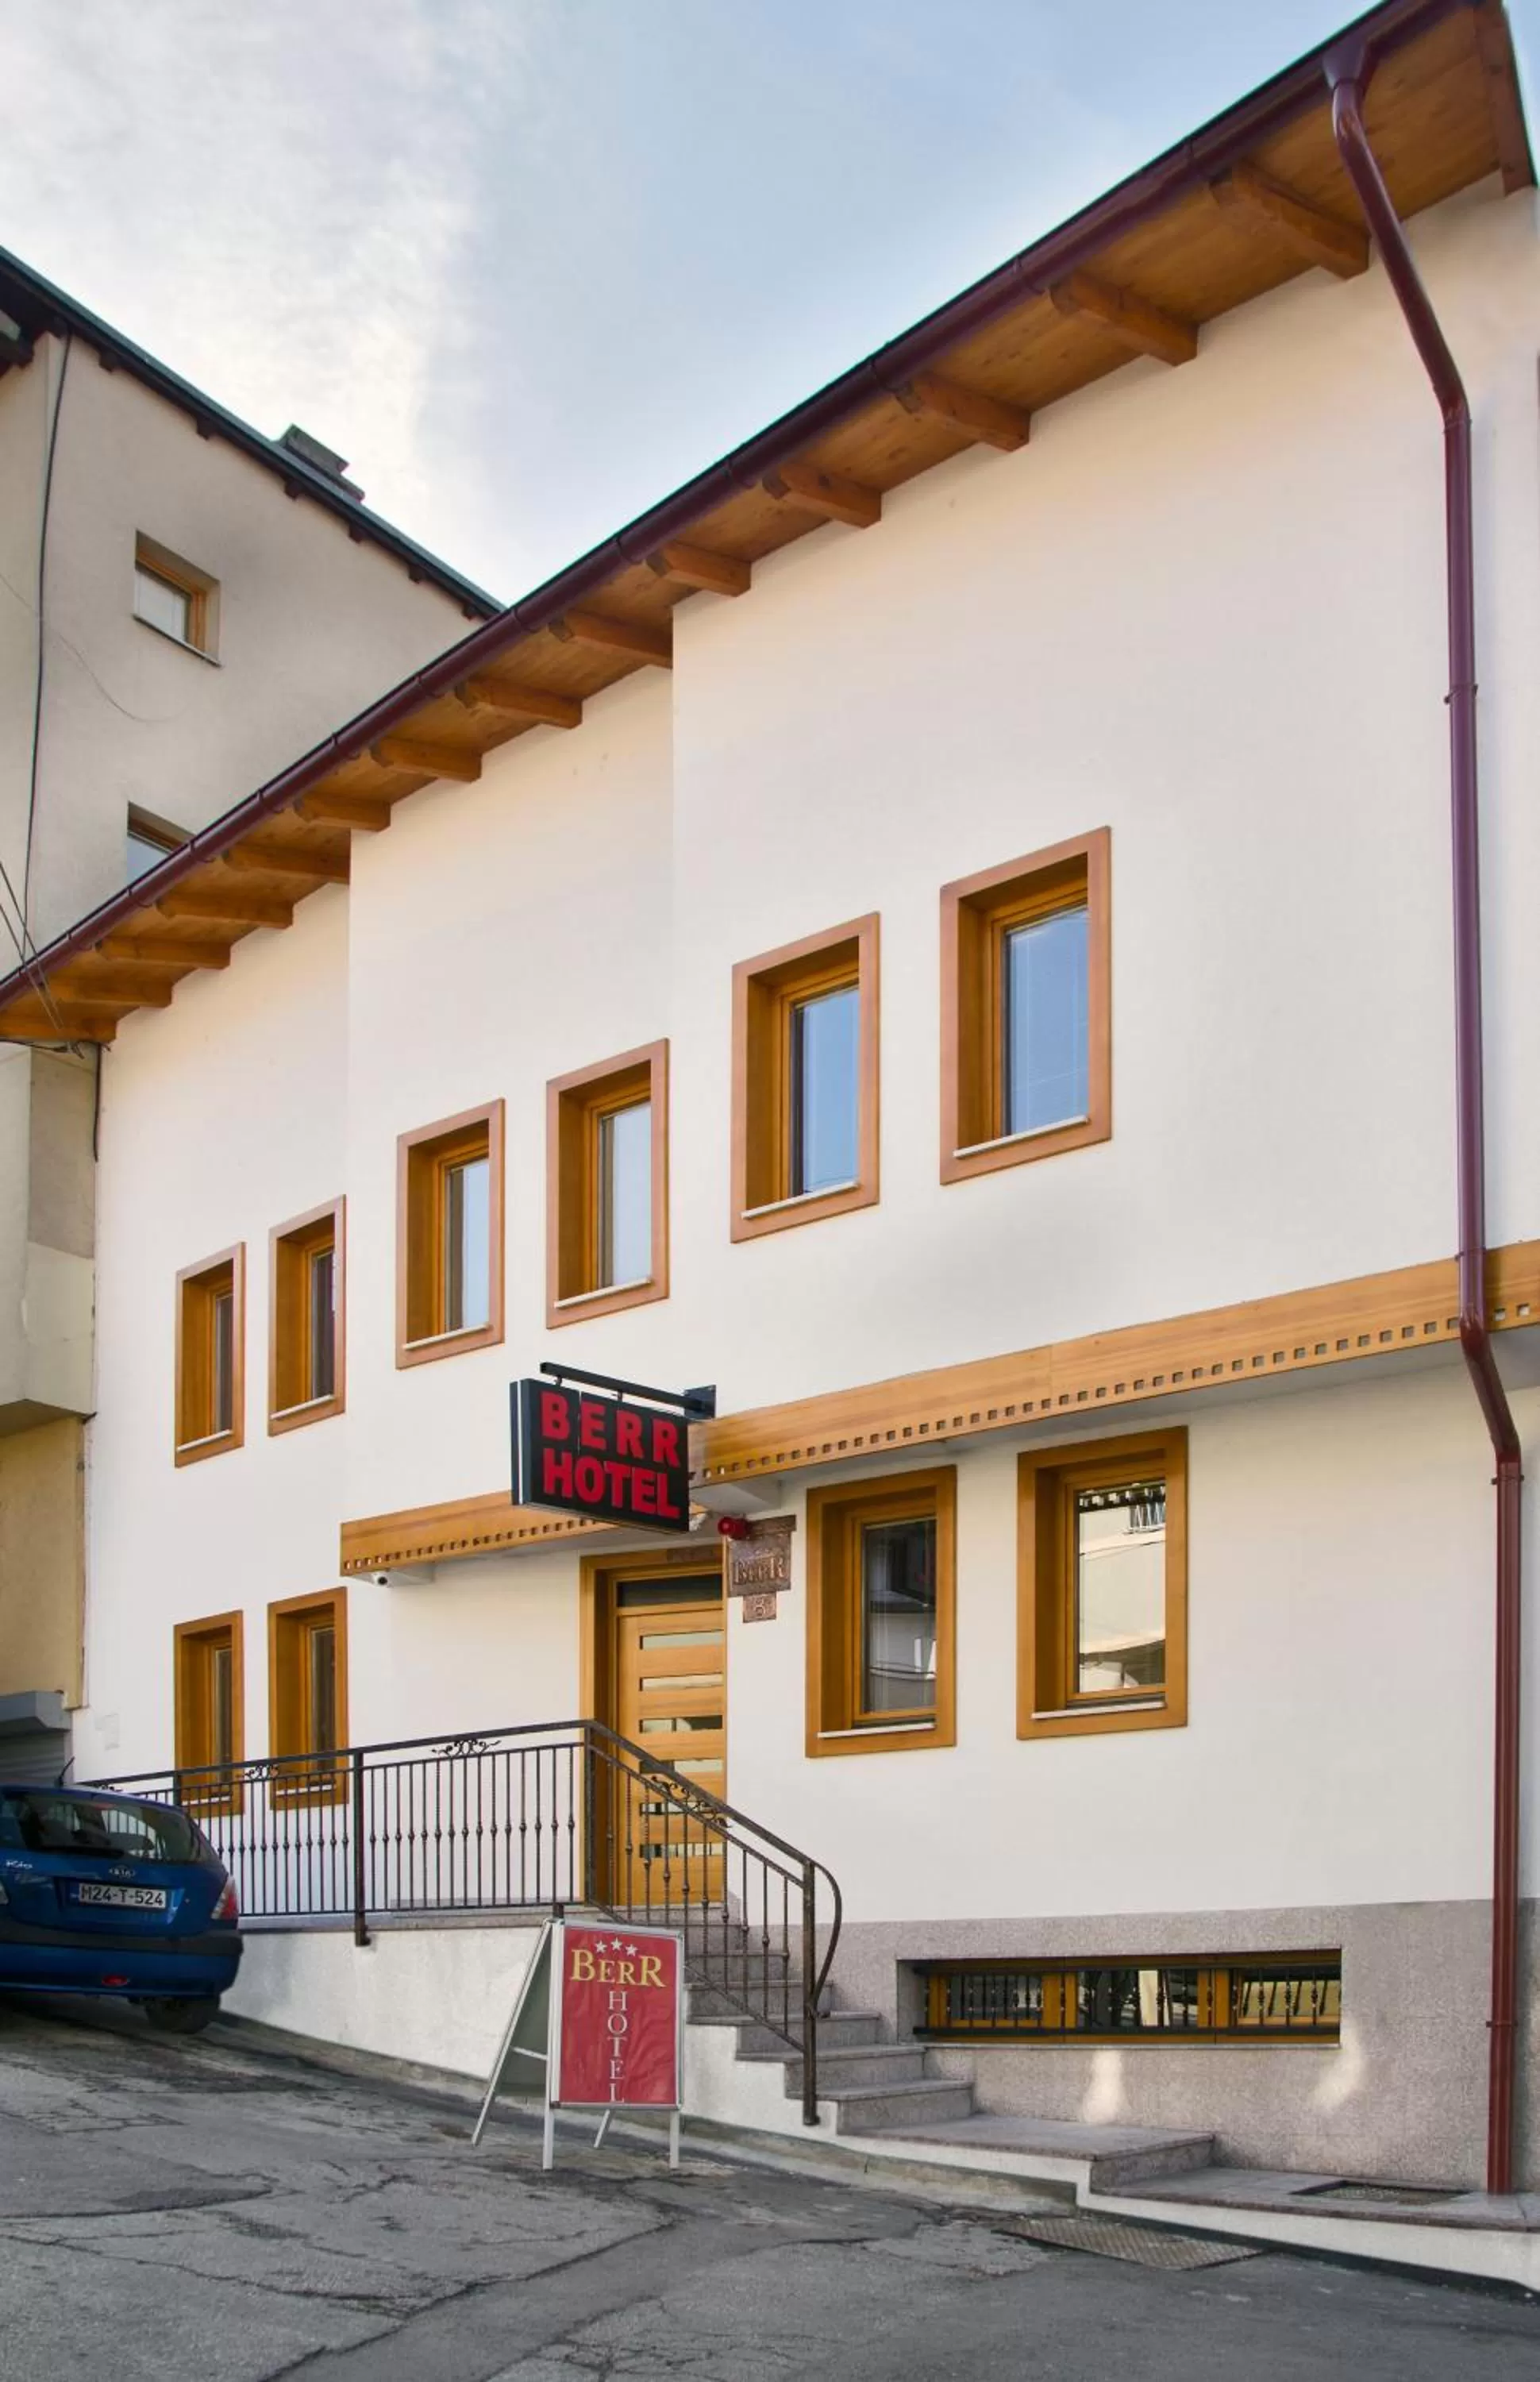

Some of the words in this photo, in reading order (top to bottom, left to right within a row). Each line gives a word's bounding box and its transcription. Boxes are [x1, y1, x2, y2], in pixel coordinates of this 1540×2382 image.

[540, 1390, 680, 1468] BERR
[542, 1447, 680, 1519] HOTEL
[569, 1948, 667, 1988] BERR
[606, 1990, 628, 2103] HOTEL
